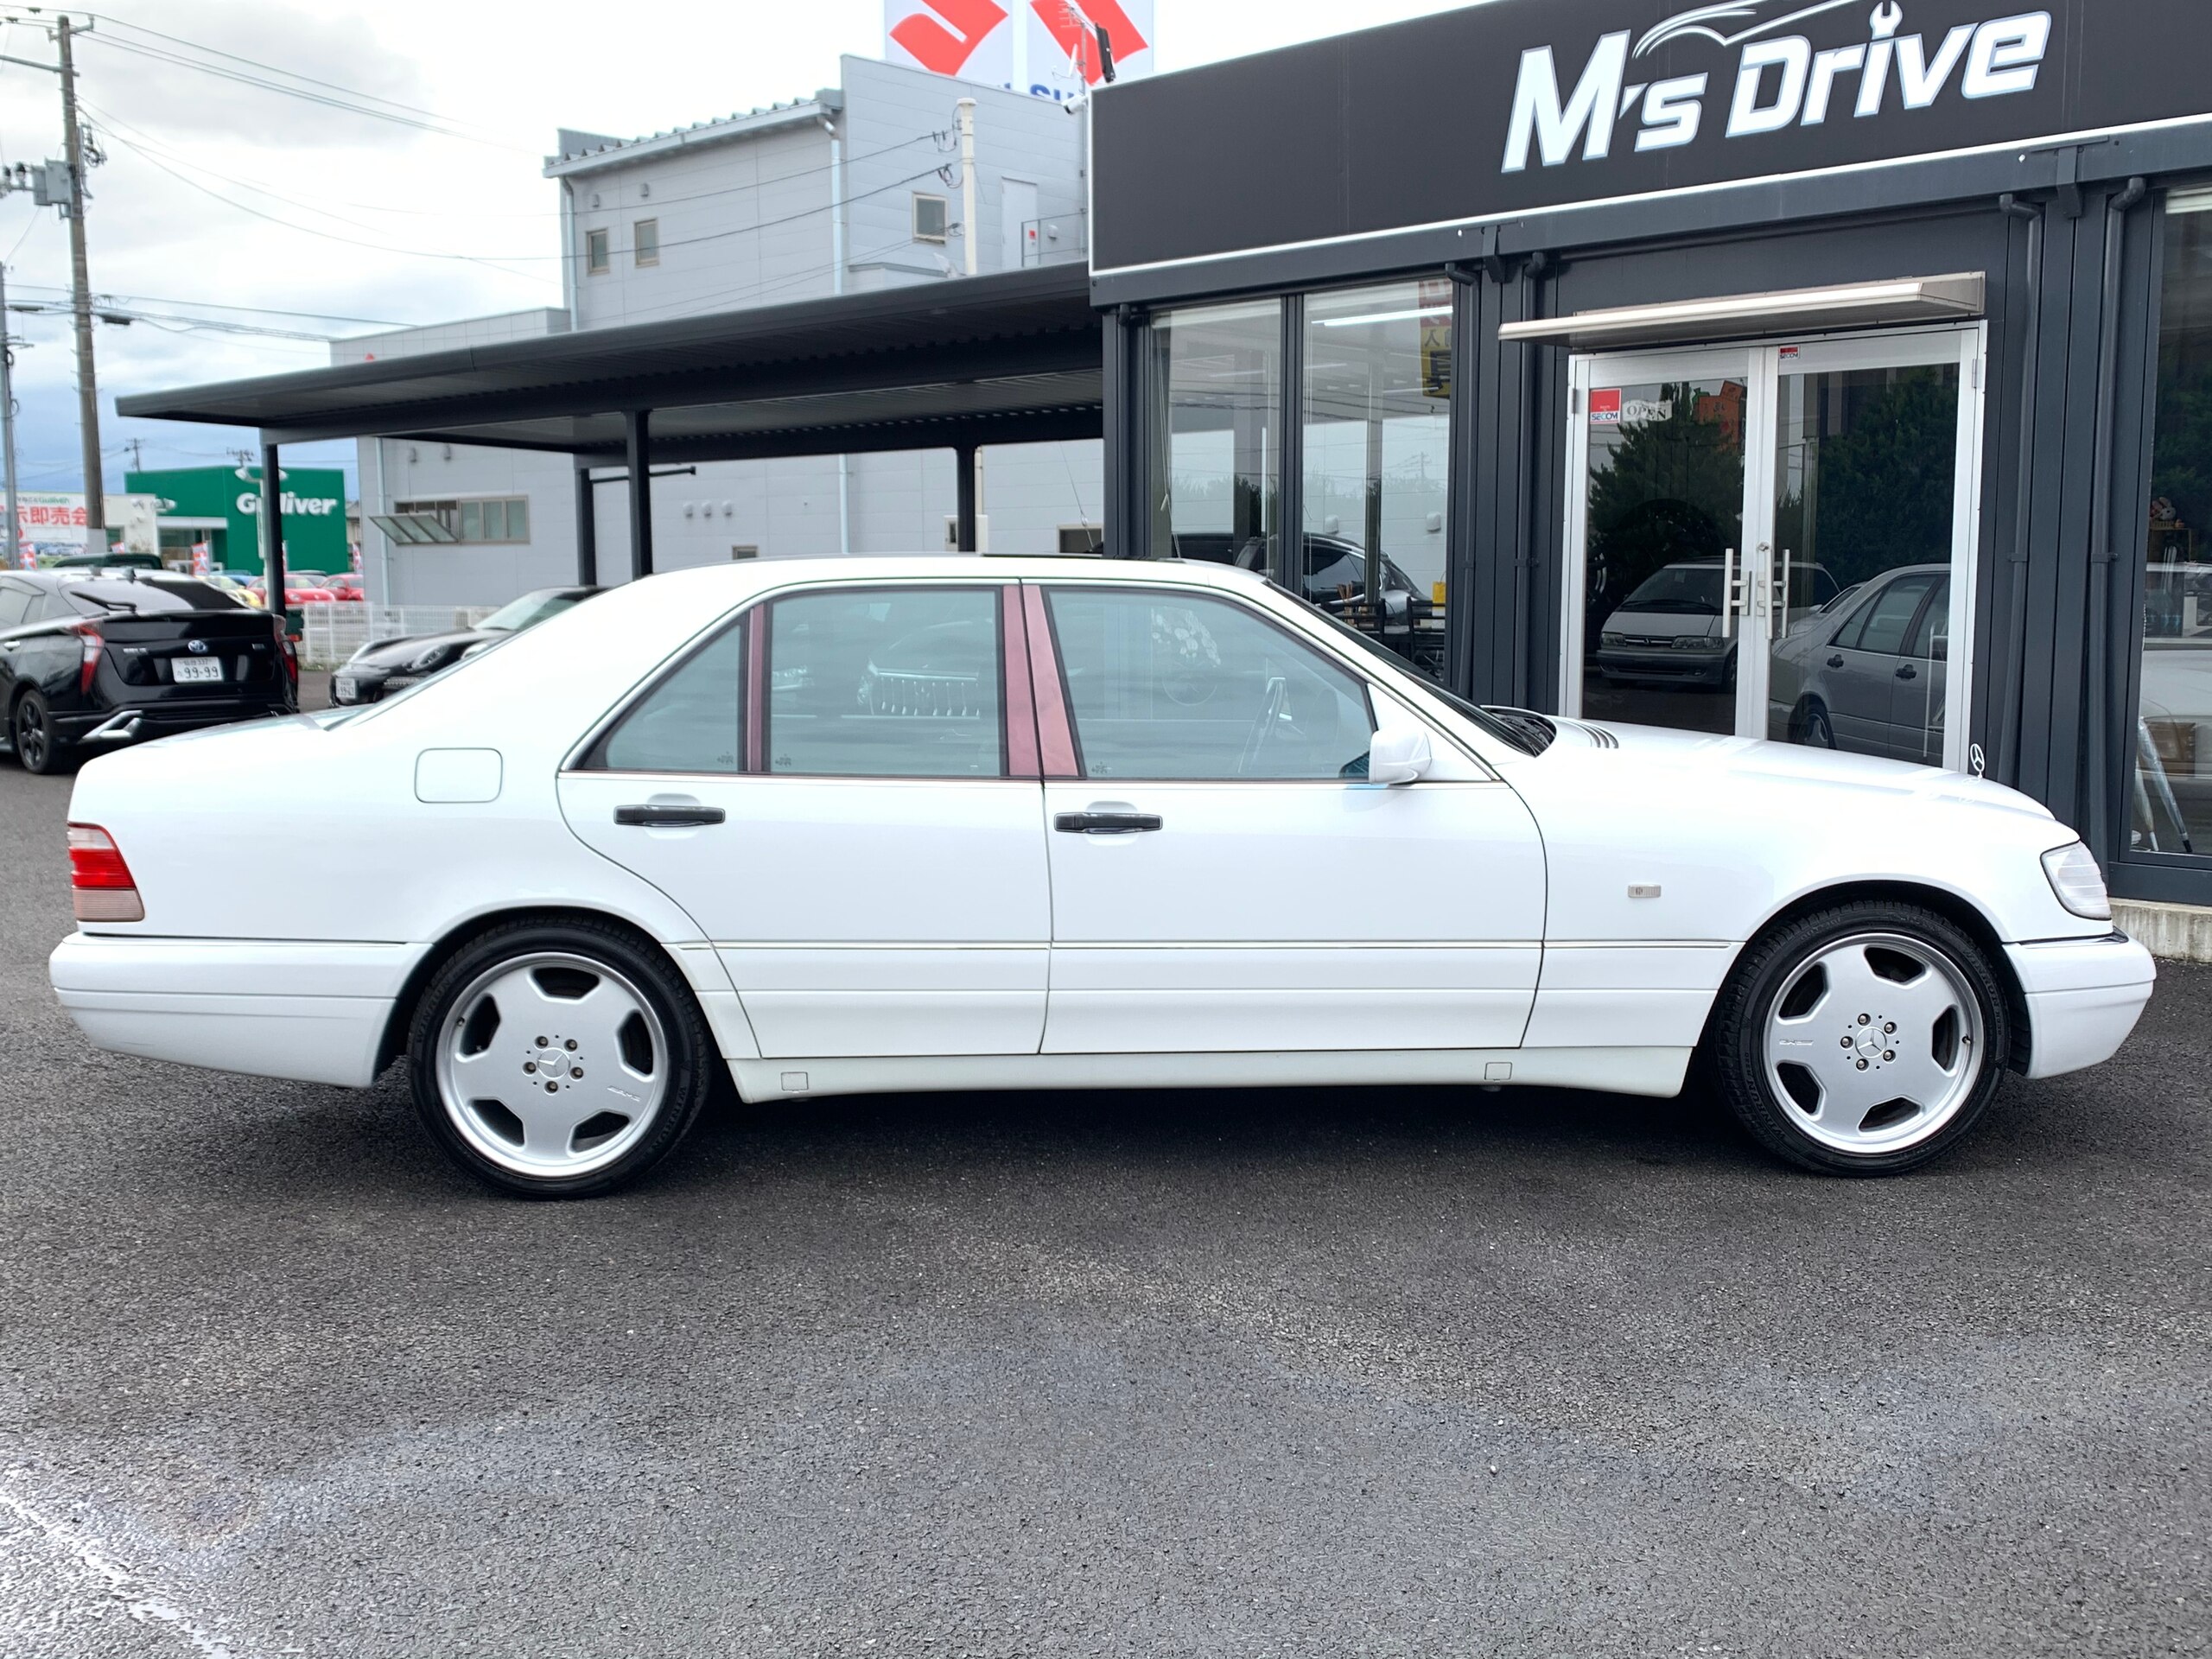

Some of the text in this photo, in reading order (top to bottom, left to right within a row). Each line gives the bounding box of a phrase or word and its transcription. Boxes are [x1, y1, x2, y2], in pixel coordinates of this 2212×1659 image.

[1501, 1, 2051, 173] M's Drive
[1592, 412, 1618, 421] SECOM
[1627, 405, 1667, 420] OPEN
[236, 491, 337, 515] Gliver
[0, 505, 88, 526] 示即売会
